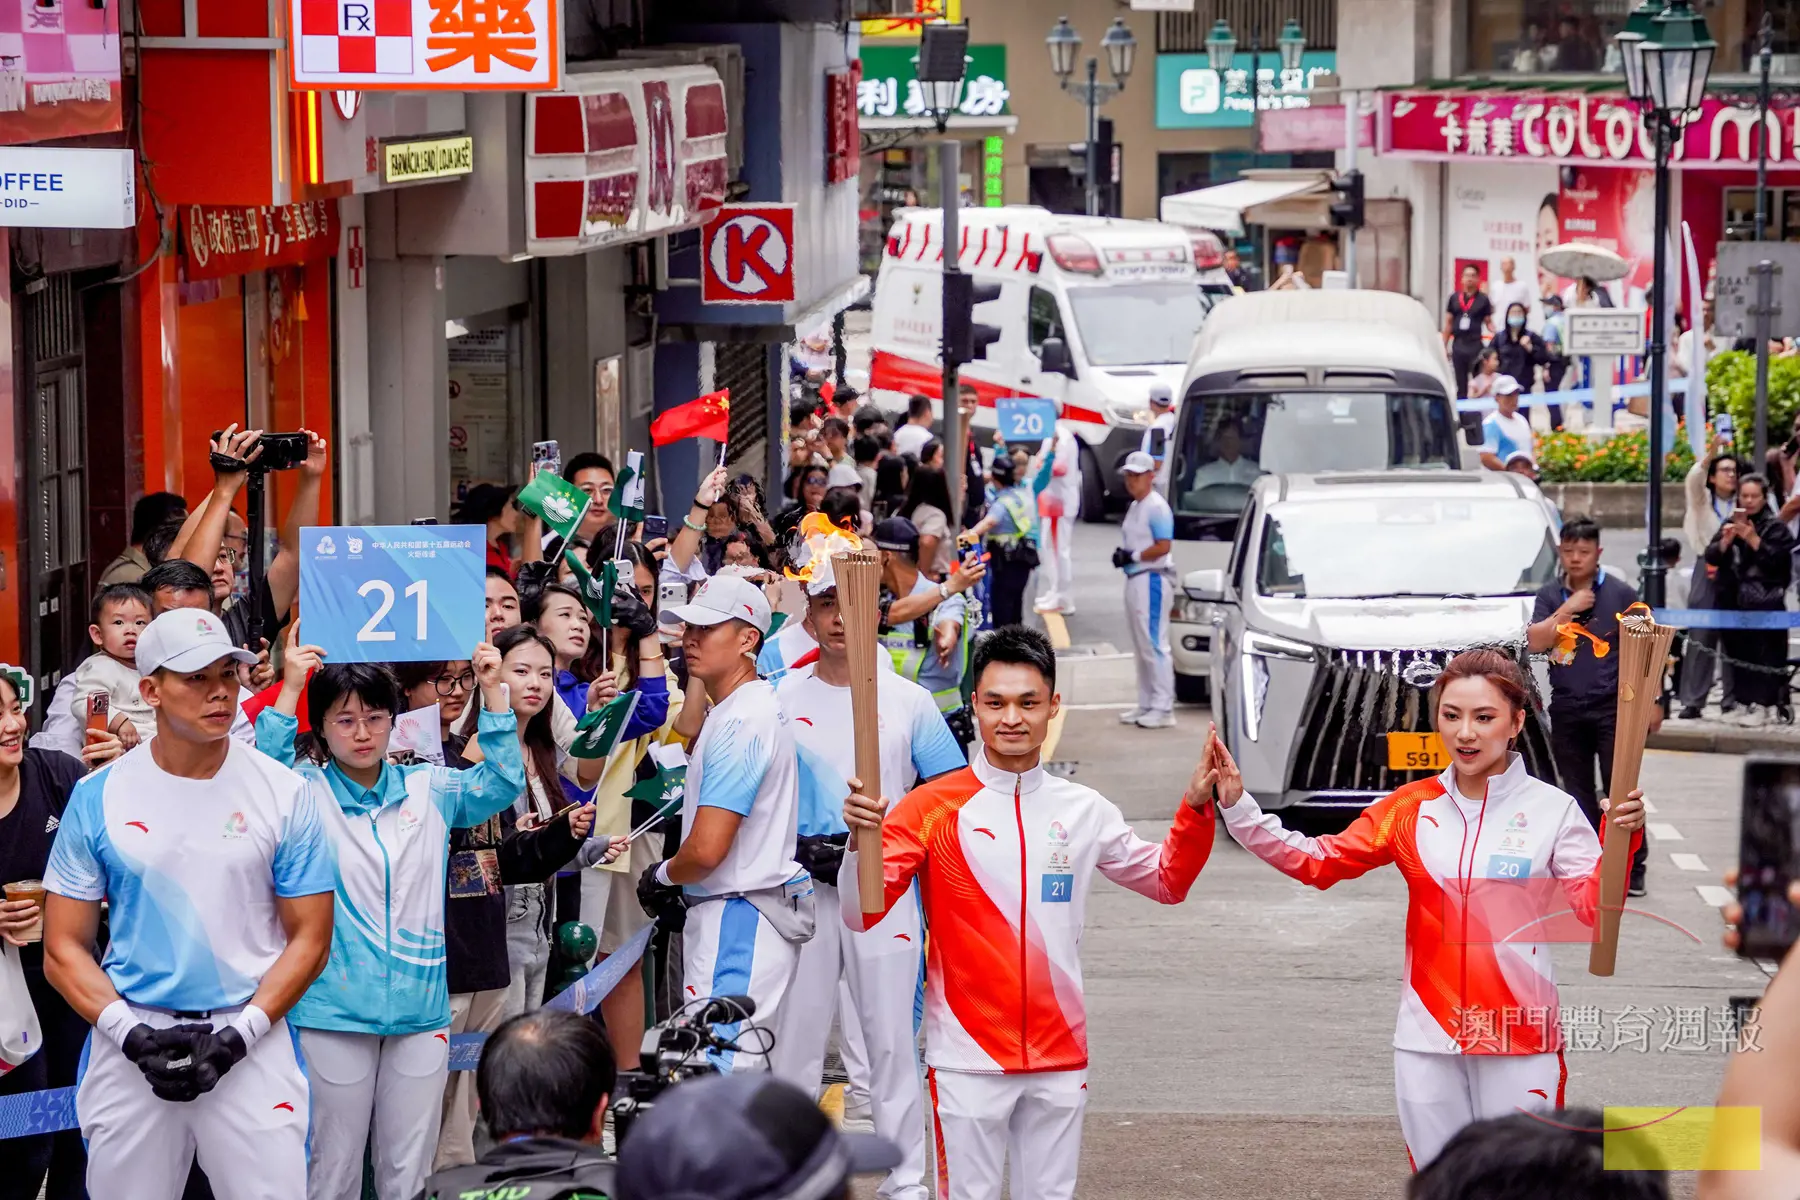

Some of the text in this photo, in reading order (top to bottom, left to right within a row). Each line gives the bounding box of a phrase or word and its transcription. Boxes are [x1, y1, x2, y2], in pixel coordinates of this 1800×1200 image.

[424, 0, 538, 73] 藥
[0, 173, 63, 191] FFEE
[1011, 413, 1043, 434] 20
[356, 579, 428, 642] 21
[1419, 735, 1430, 750] T
[1406, 751, 1439, 767] 591
[1497, 861, 1520, 878] 20
[1051, 881, 1065, 896] 21
